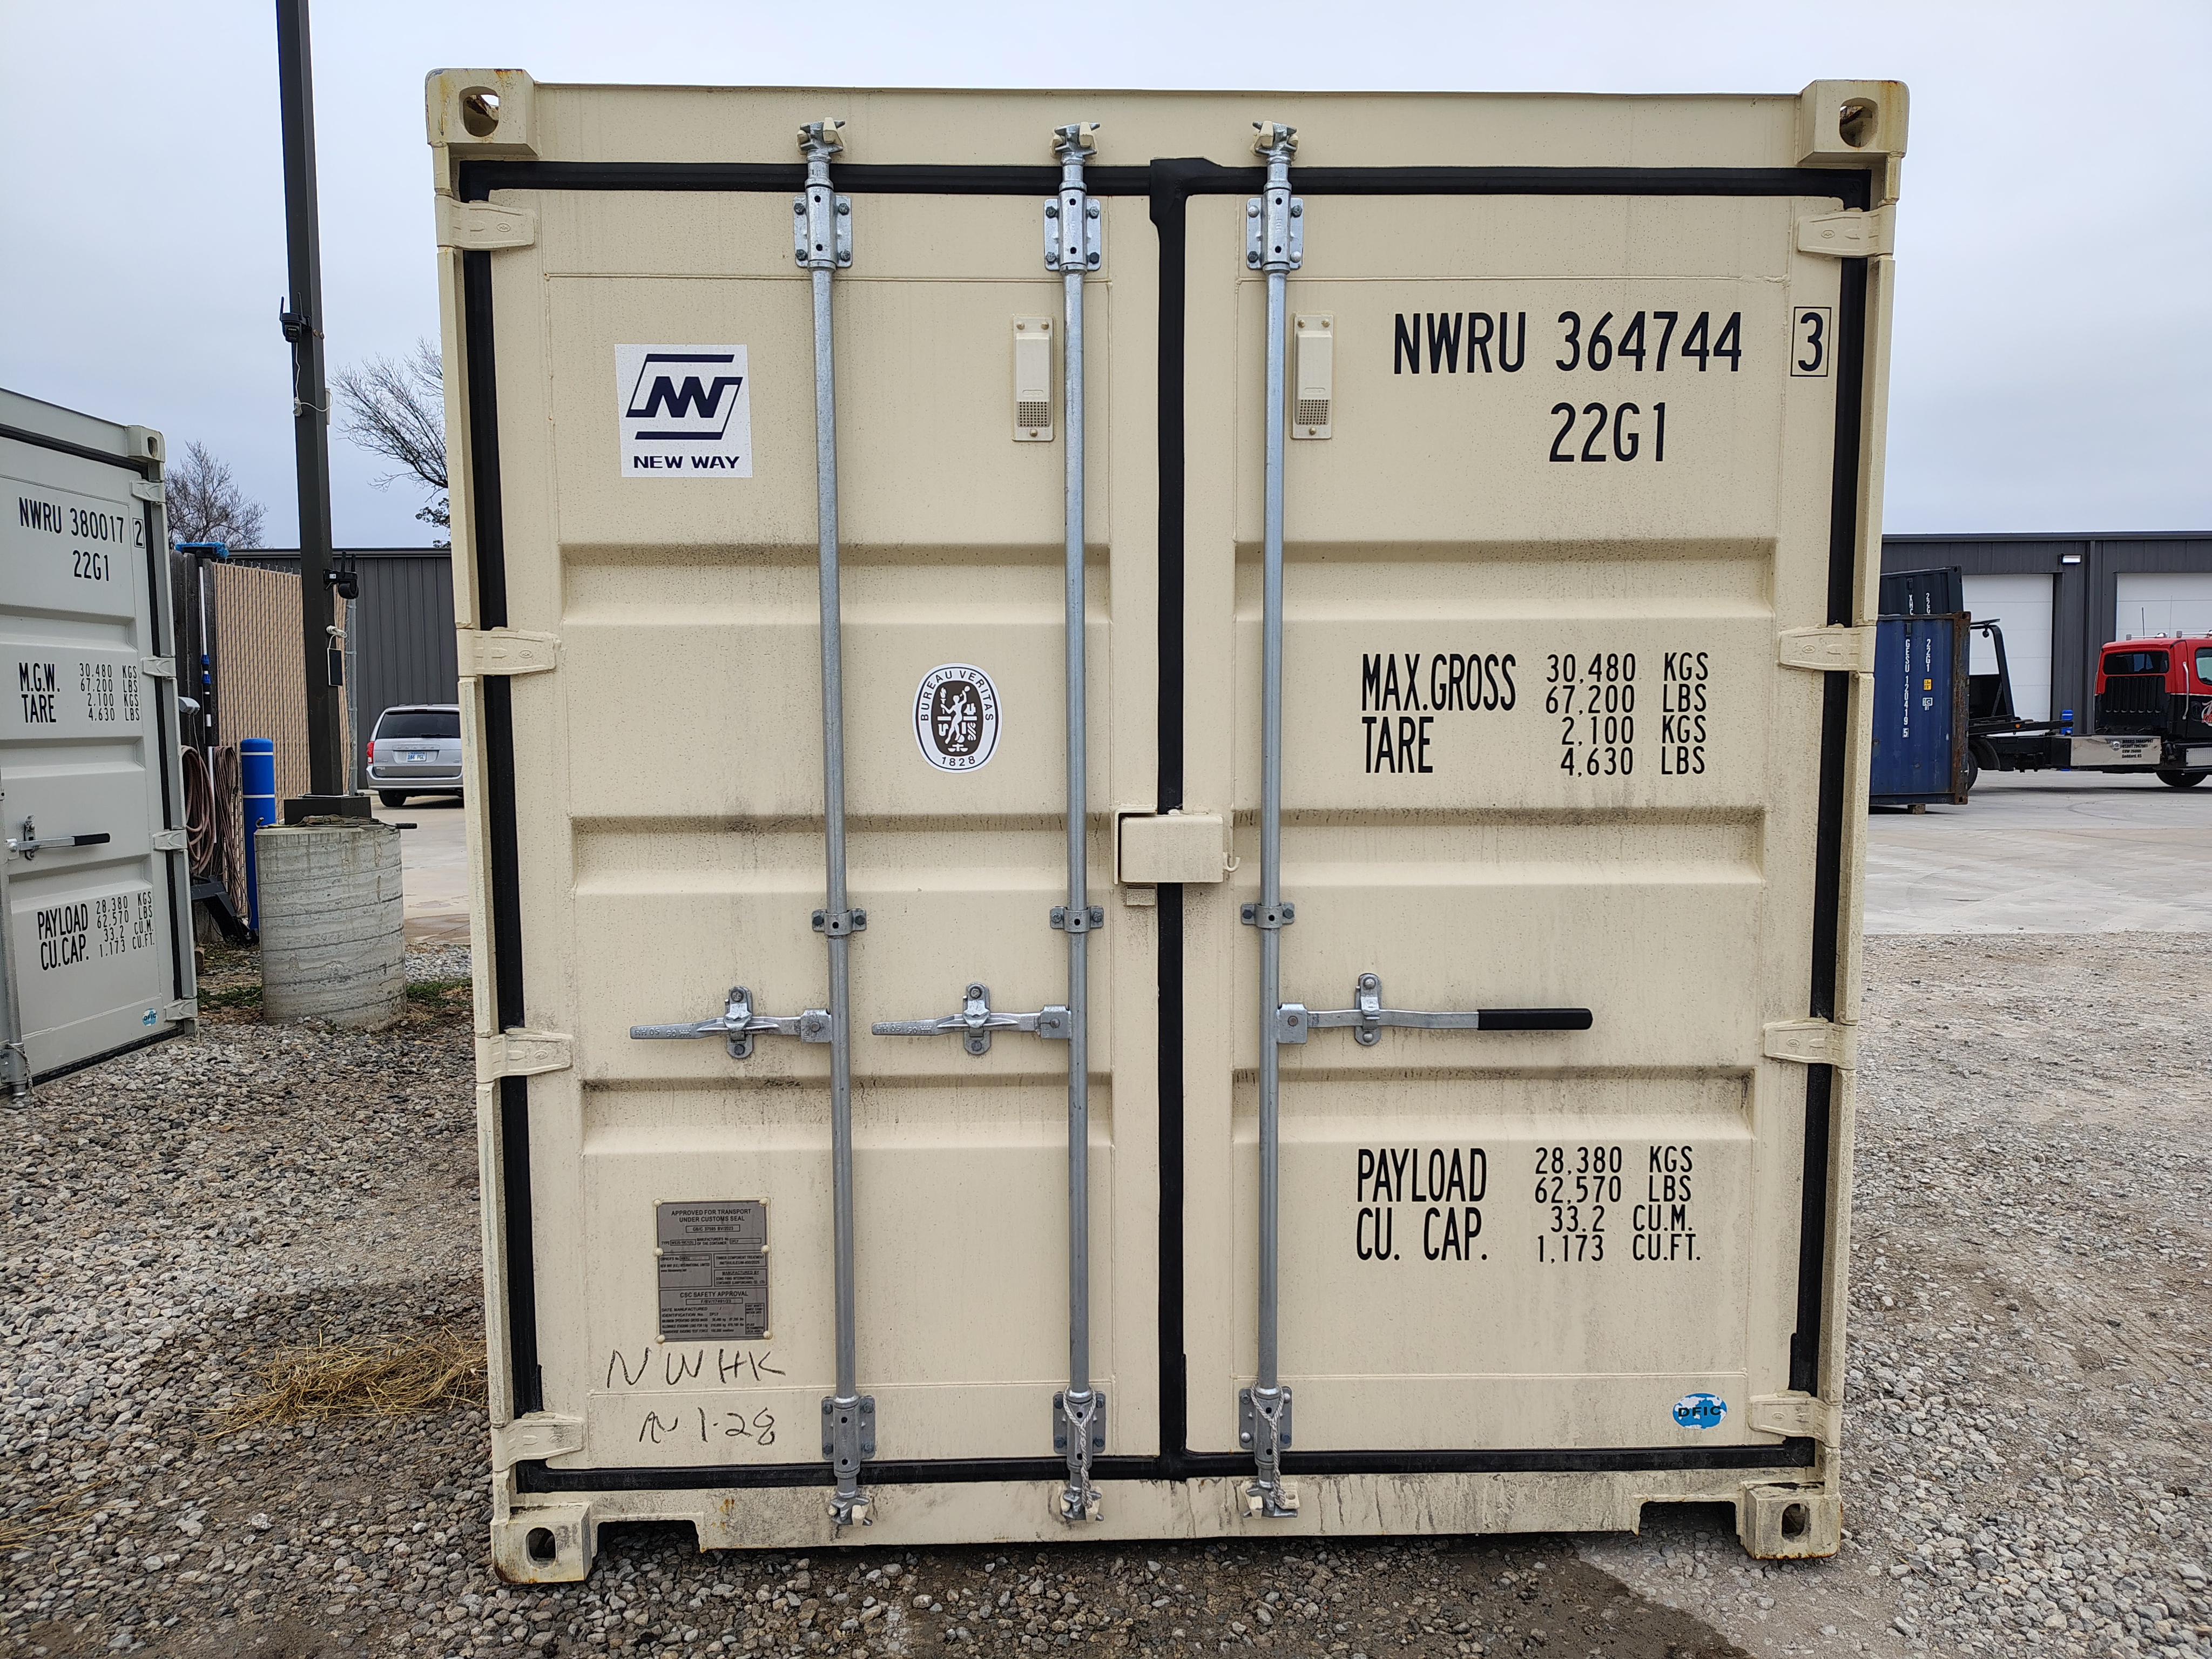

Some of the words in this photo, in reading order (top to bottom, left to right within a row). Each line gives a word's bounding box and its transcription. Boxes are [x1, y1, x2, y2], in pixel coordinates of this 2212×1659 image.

[1394, 312, 1526, 375] NWRU
[1555, 311, 1742, 372] 364744
[1798, 312, 1823, 372] 3
[1549, 402, 1665, 462] 22G1
[633, 456, 683, 469] NEW
[691, 456, 740, 469] WAY
[19, 496, 62, 534] NWRU
[70, 508, 124, 544] 380017
[134, 520, 143, 547] 2
[72, 550, 109, 582] 22G1
[19, 662, 60, 692] M.G.W.
[122, 665, 137, 679] KGS
[1361, 653, 1516, 711] MAX.GROSS
[1546, 653, 1636, 684] 30,480
[1663, 652, 1709, 682] KGS
[123, 679, 138, 693] LBS
[124, 693, 139, 707] KGS
[920, 670, 952, 721] BUREAU
[959, 670, 994, 721] VERITAS
[1546, 684, 1635, 715] 67,200
[1663, 683, 1707, 713] LBS
[21, 694, 56, 723] TARE
[125, 707, 140, 721] LBS
[1662, 714, 1707, 744] KGS
[1903, 728, 1908, 737] 5
[1361, 716, 1434, 773] TARE
[941, 756, 975, 766] 1828
[1661, 745, 1705, 775] LBS
[137, 891, 152, 906] KGS
[138, 905, 153, 920] LBS
[37, 903, 89, 940] PAYLOAD
[103, 925, 125, 942] 33.2
[134, 919, 154, 935] CU.M.
[132, 932, 155, 950] CU.FT.
[1357, 1148, 1487, 1202] PAYLOAD
[1535, 1146, 1622, 1176] 28,380
[1649, 1145, 1693, 1173] KGS
[1649, 1175, 1691, 1202] LBS
[1550, 1205, 1605, 1233] 33.2
[1633, 1204, 1692, 1232] CU.M.
[1356, 1207, 1400, 1261] CU.
[1424, 1206, 1487, 1261] CAP.
[1633, 1233, 1701, 1261] CU.FT.
[1678, 1406, 1722, 1417] DFIC
